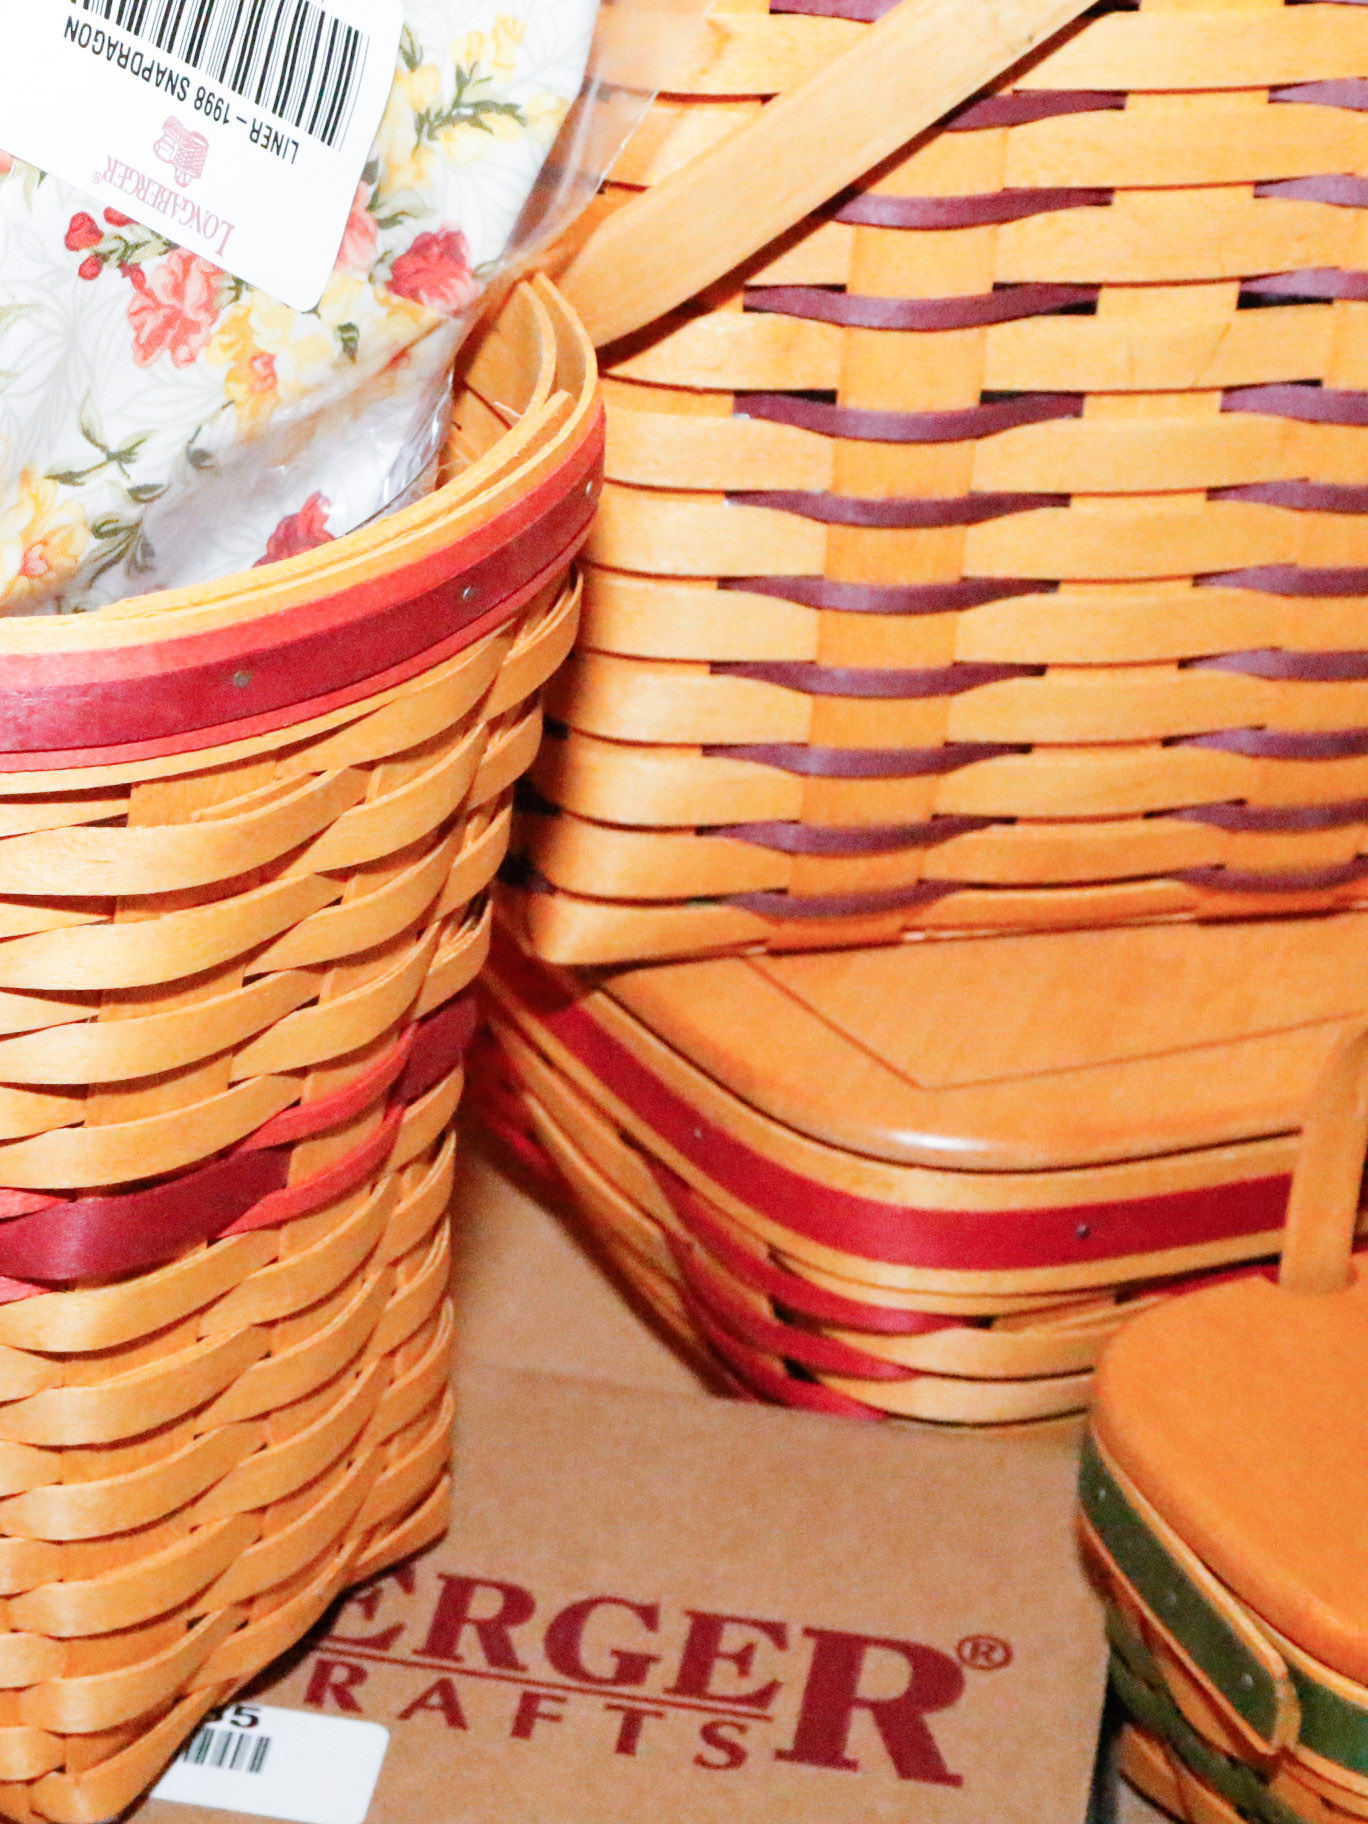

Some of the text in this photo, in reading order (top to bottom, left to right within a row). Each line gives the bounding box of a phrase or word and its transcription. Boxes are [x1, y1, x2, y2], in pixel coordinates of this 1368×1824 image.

[63, 15, 191, 103] SNAPDRAGON
[193, 86, 231, 125] 1998
[248, 118, 301, 165] LINER
